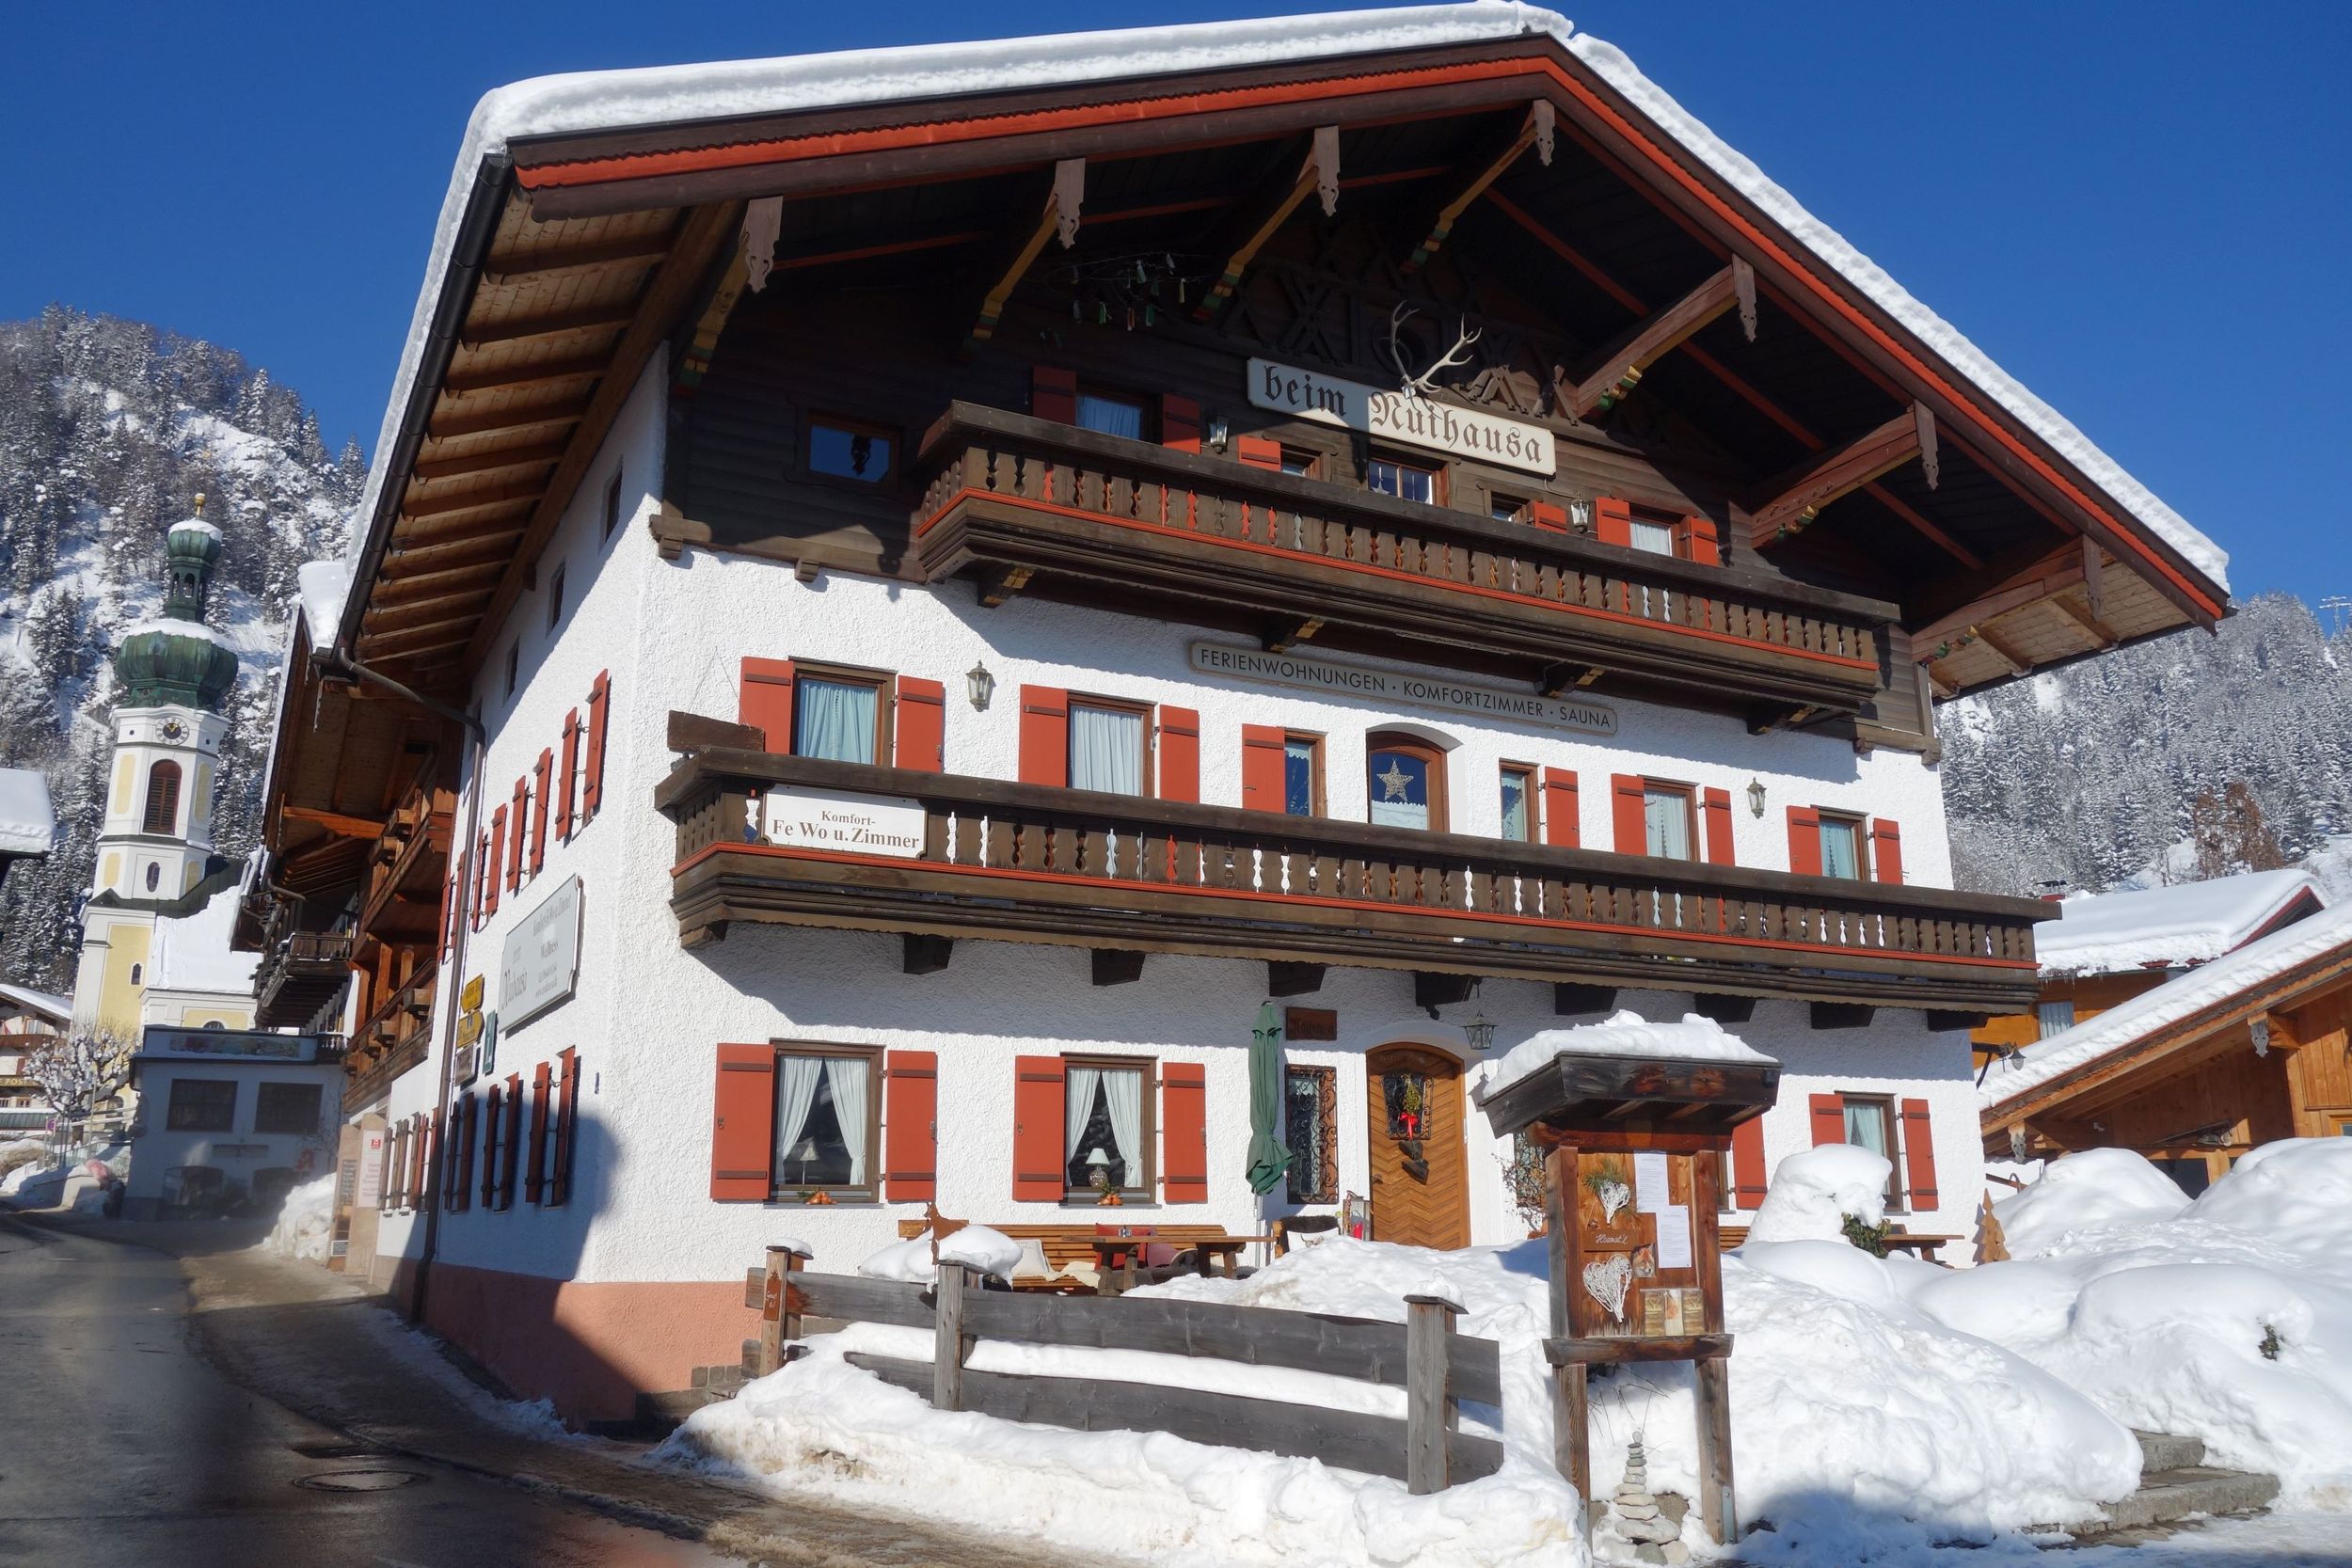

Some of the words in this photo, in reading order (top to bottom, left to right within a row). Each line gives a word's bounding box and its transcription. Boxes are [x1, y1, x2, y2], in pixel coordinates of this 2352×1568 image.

[1264, 364, 1347, 417] beim
[1200, 648, 1386, 692] FERIENWOHNUNGEN
[1404, 681, 1544, 717] KOMFORTZIMMER
[1559, 705, 1612, 728] SAUNA
[772, 818, 794, 836] Fe
[799, 821, 828, 840] Wo
[851, 827, 920, 849] Zimmer
[821, 810, 876, 826] Komfort-
